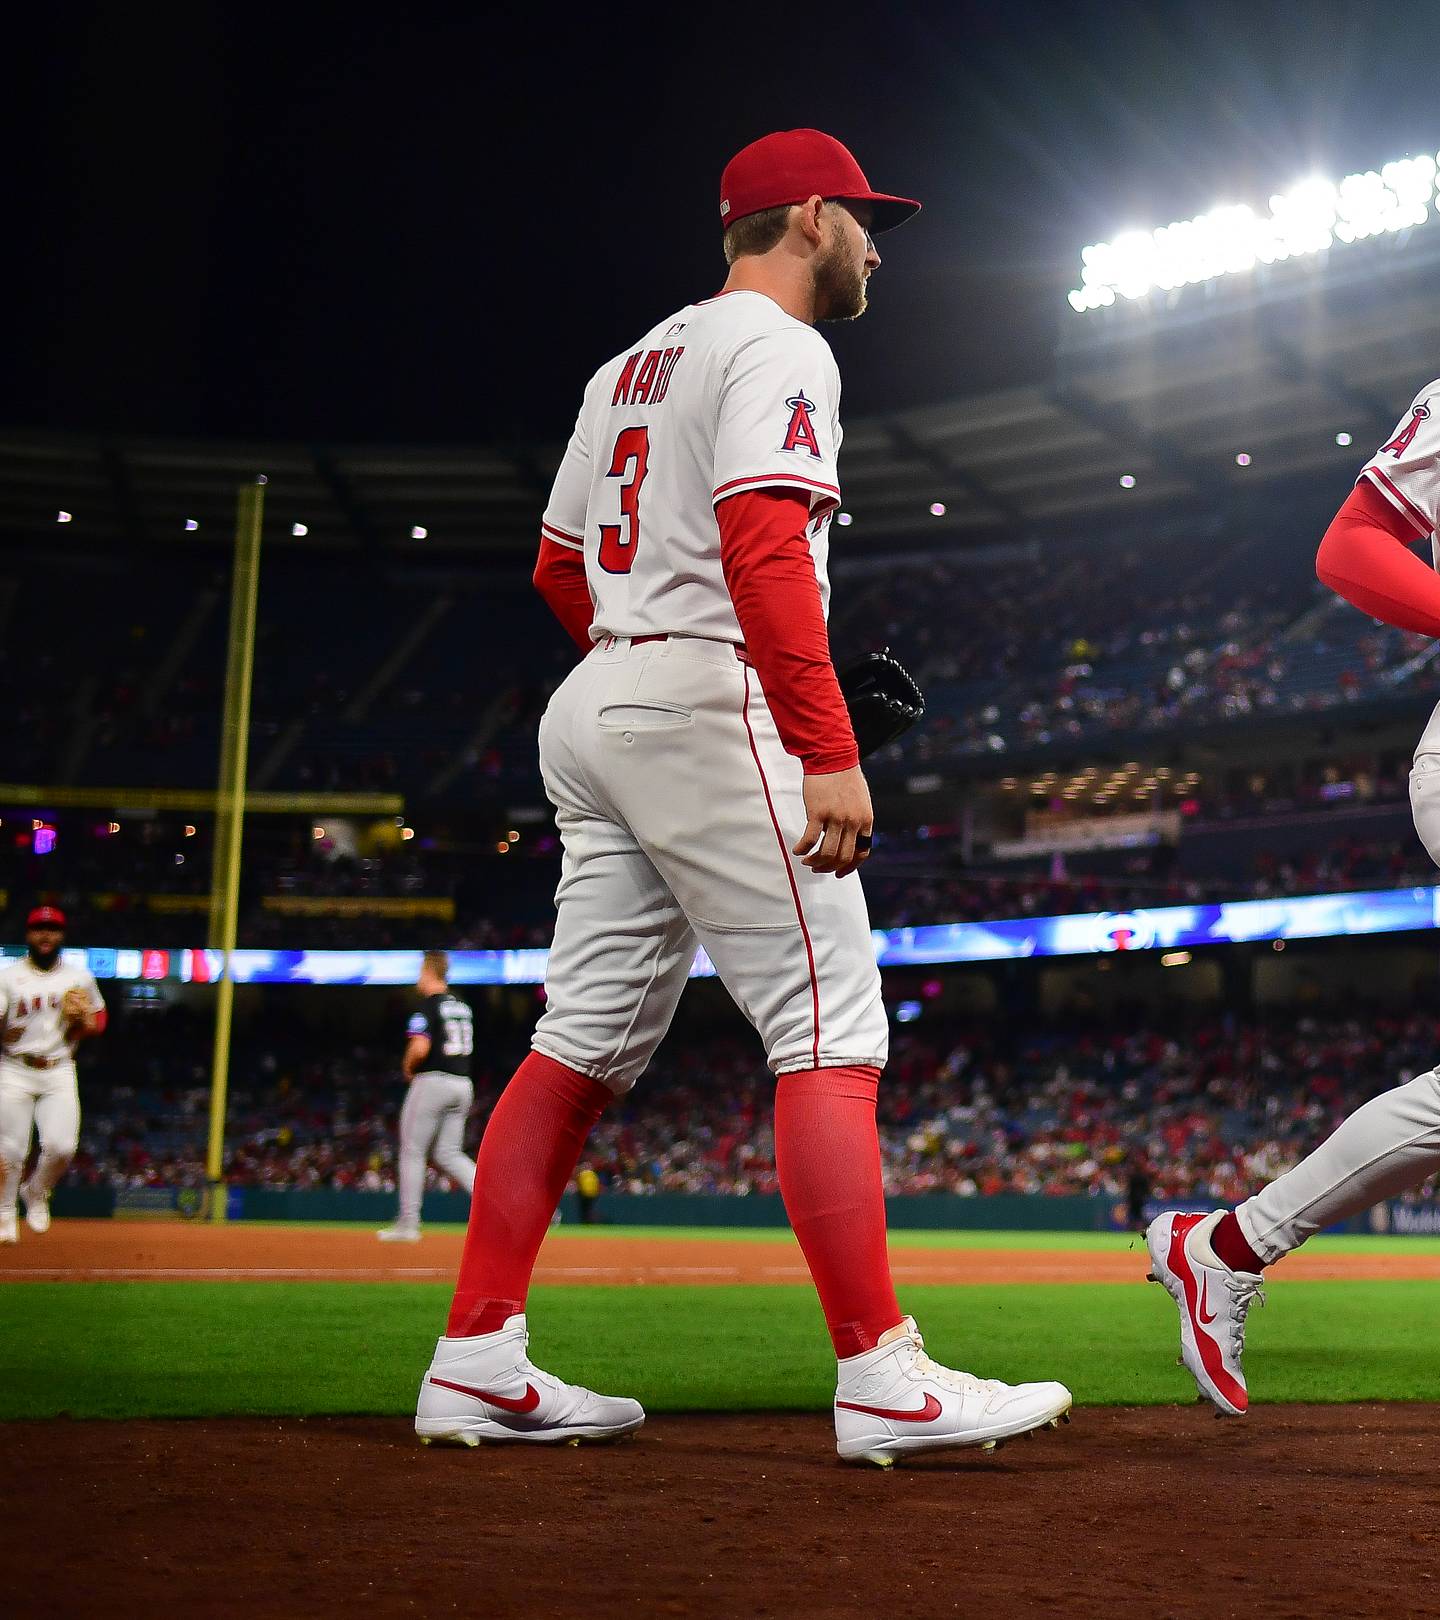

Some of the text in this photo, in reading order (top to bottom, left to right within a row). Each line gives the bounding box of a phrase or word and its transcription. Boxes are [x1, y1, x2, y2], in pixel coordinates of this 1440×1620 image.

[781, 388, 822, 460] A
[1379, 398, 1431, 459] A
[597, 425, 649, 575] 3
